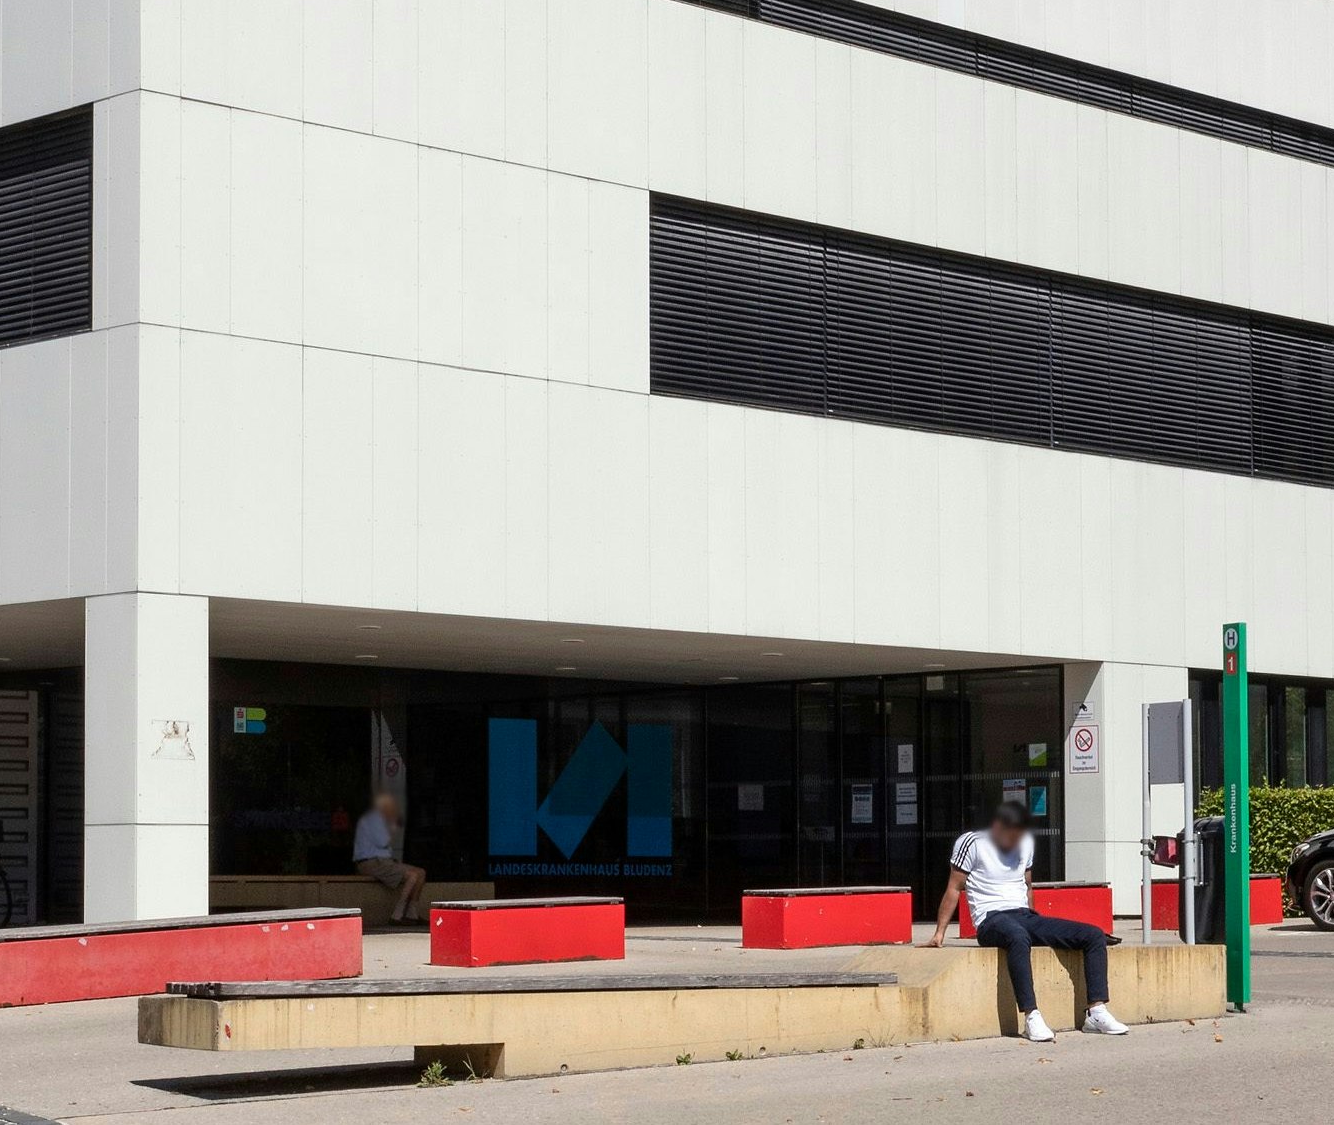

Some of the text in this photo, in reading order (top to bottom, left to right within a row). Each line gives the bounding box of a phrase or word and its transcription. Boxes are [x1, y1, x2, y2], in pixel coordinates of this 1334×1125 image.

[1227, 631, 1235, 646] H
[1227, 656, 1234, 671] 1
[488, 863, 673, 876] LANDESKRANKENHAUS BLUDENZ
